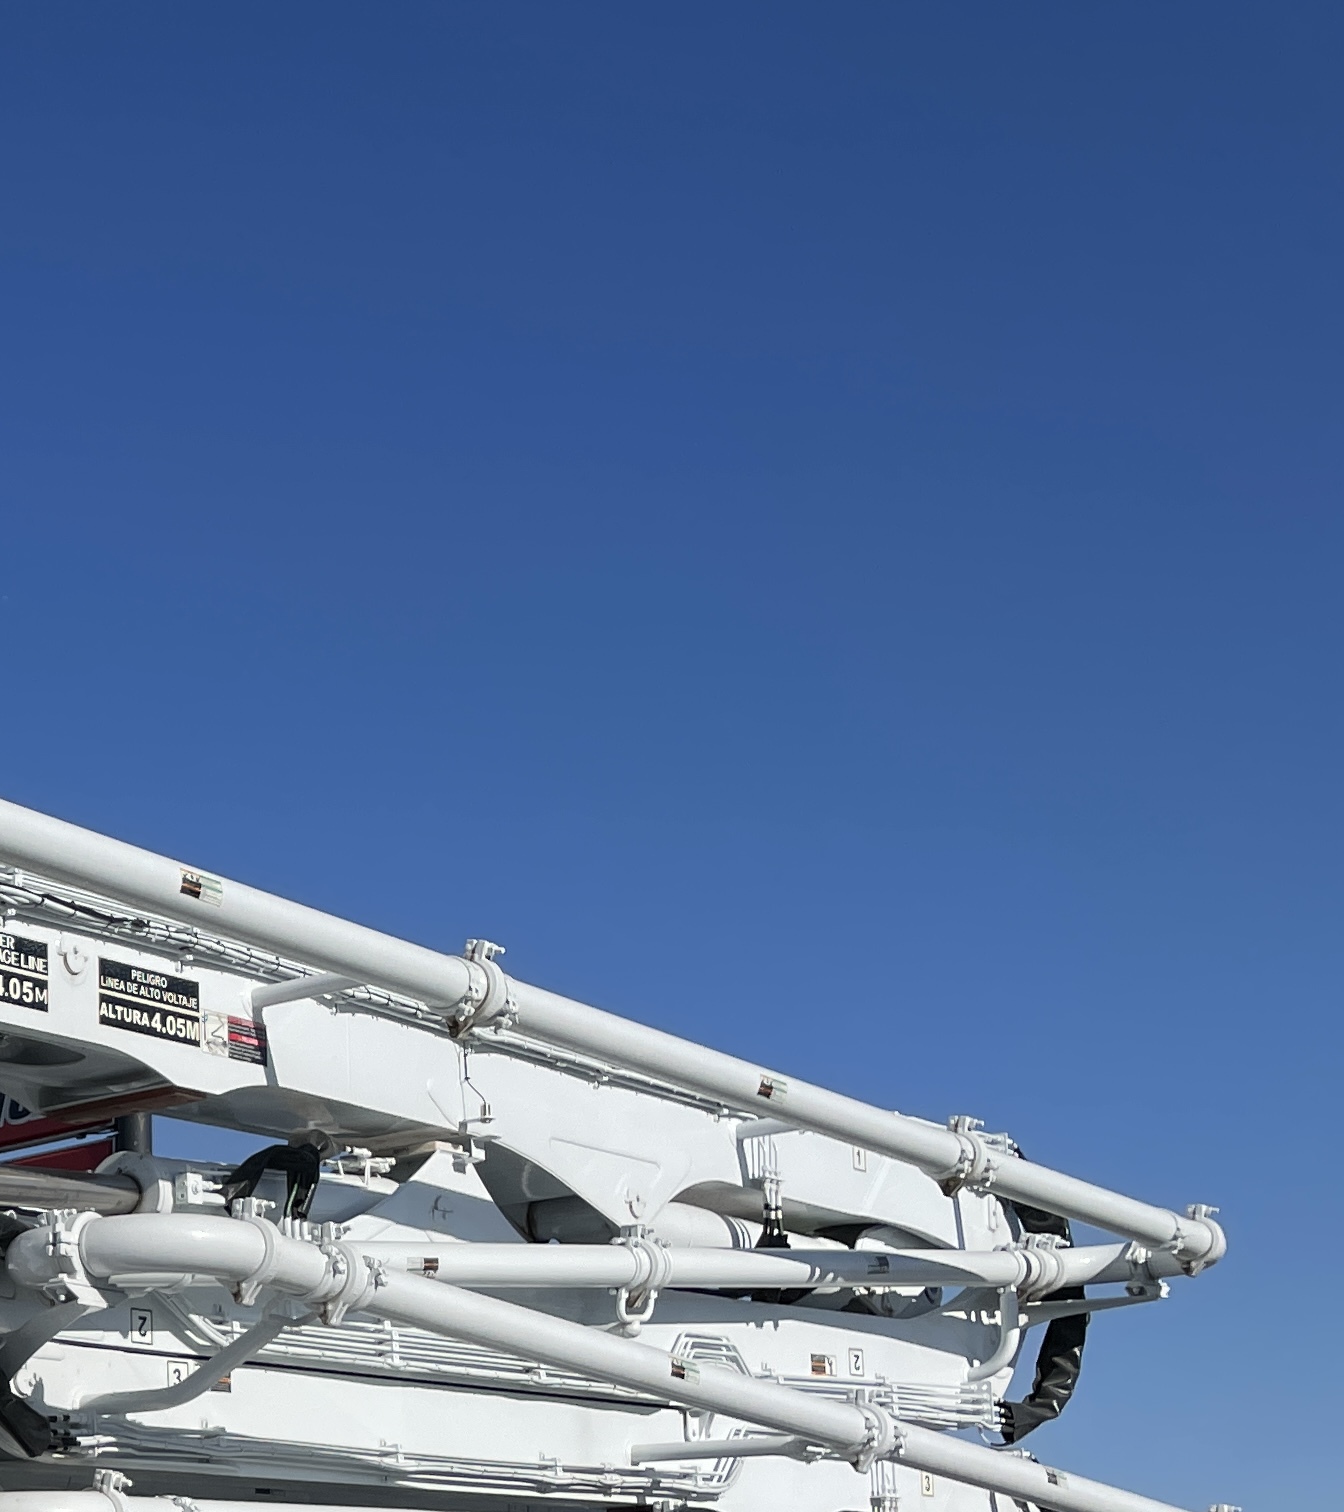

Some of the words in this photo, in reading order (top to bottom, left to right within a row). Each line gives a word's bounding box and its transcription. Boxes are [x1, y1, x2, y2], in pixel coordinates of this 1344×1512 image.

[20, 953, 48, 974] LINE
[131, 969, 168, 989] PELIGRO
[126, 981, 139, 995] DE
[139, 985, 161, 1000] ALTO
[161, 991, 198, 1010] VOLTAJE
[99, 1002, 151, 1028] ALTURA
[150, 1012, 200, 1041] 4.05M
